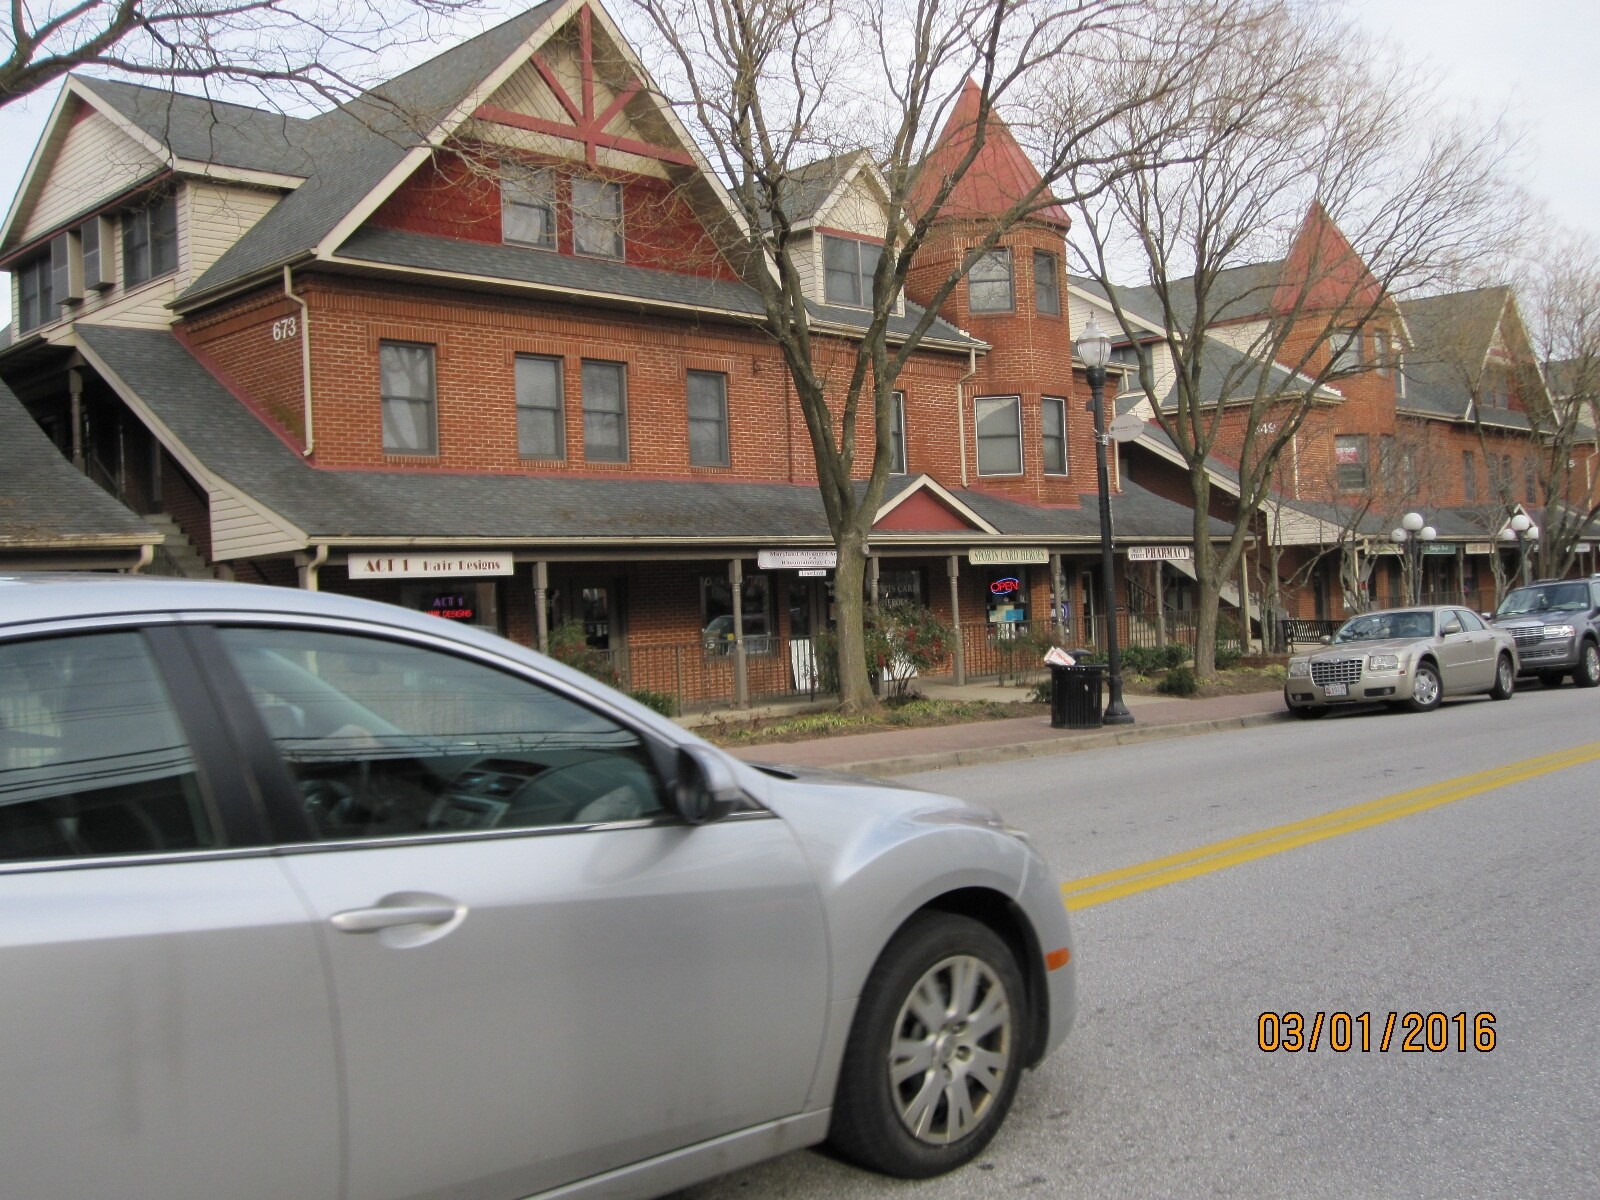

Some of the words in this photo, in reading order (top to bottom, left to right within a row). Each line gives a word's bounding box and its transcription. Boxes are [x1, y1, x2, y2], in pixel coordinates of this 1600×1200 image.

[273, 317, 296, 340] 673
[974, 550, 998, 561] SPORTS
[1001, 550, 1019, 560] CARD
[1021, 549, 1045, 560] HEROES
[1145, 547, 1187, 558] PHARMACY
[364, 559, 395, 572] ACT
[458, 560, 500, 571] Designs
[990, 581, 1019, 592] OPEN
[433, 597, 454, 607] ACT
[442, 609, 473, 618] DESIGNS
